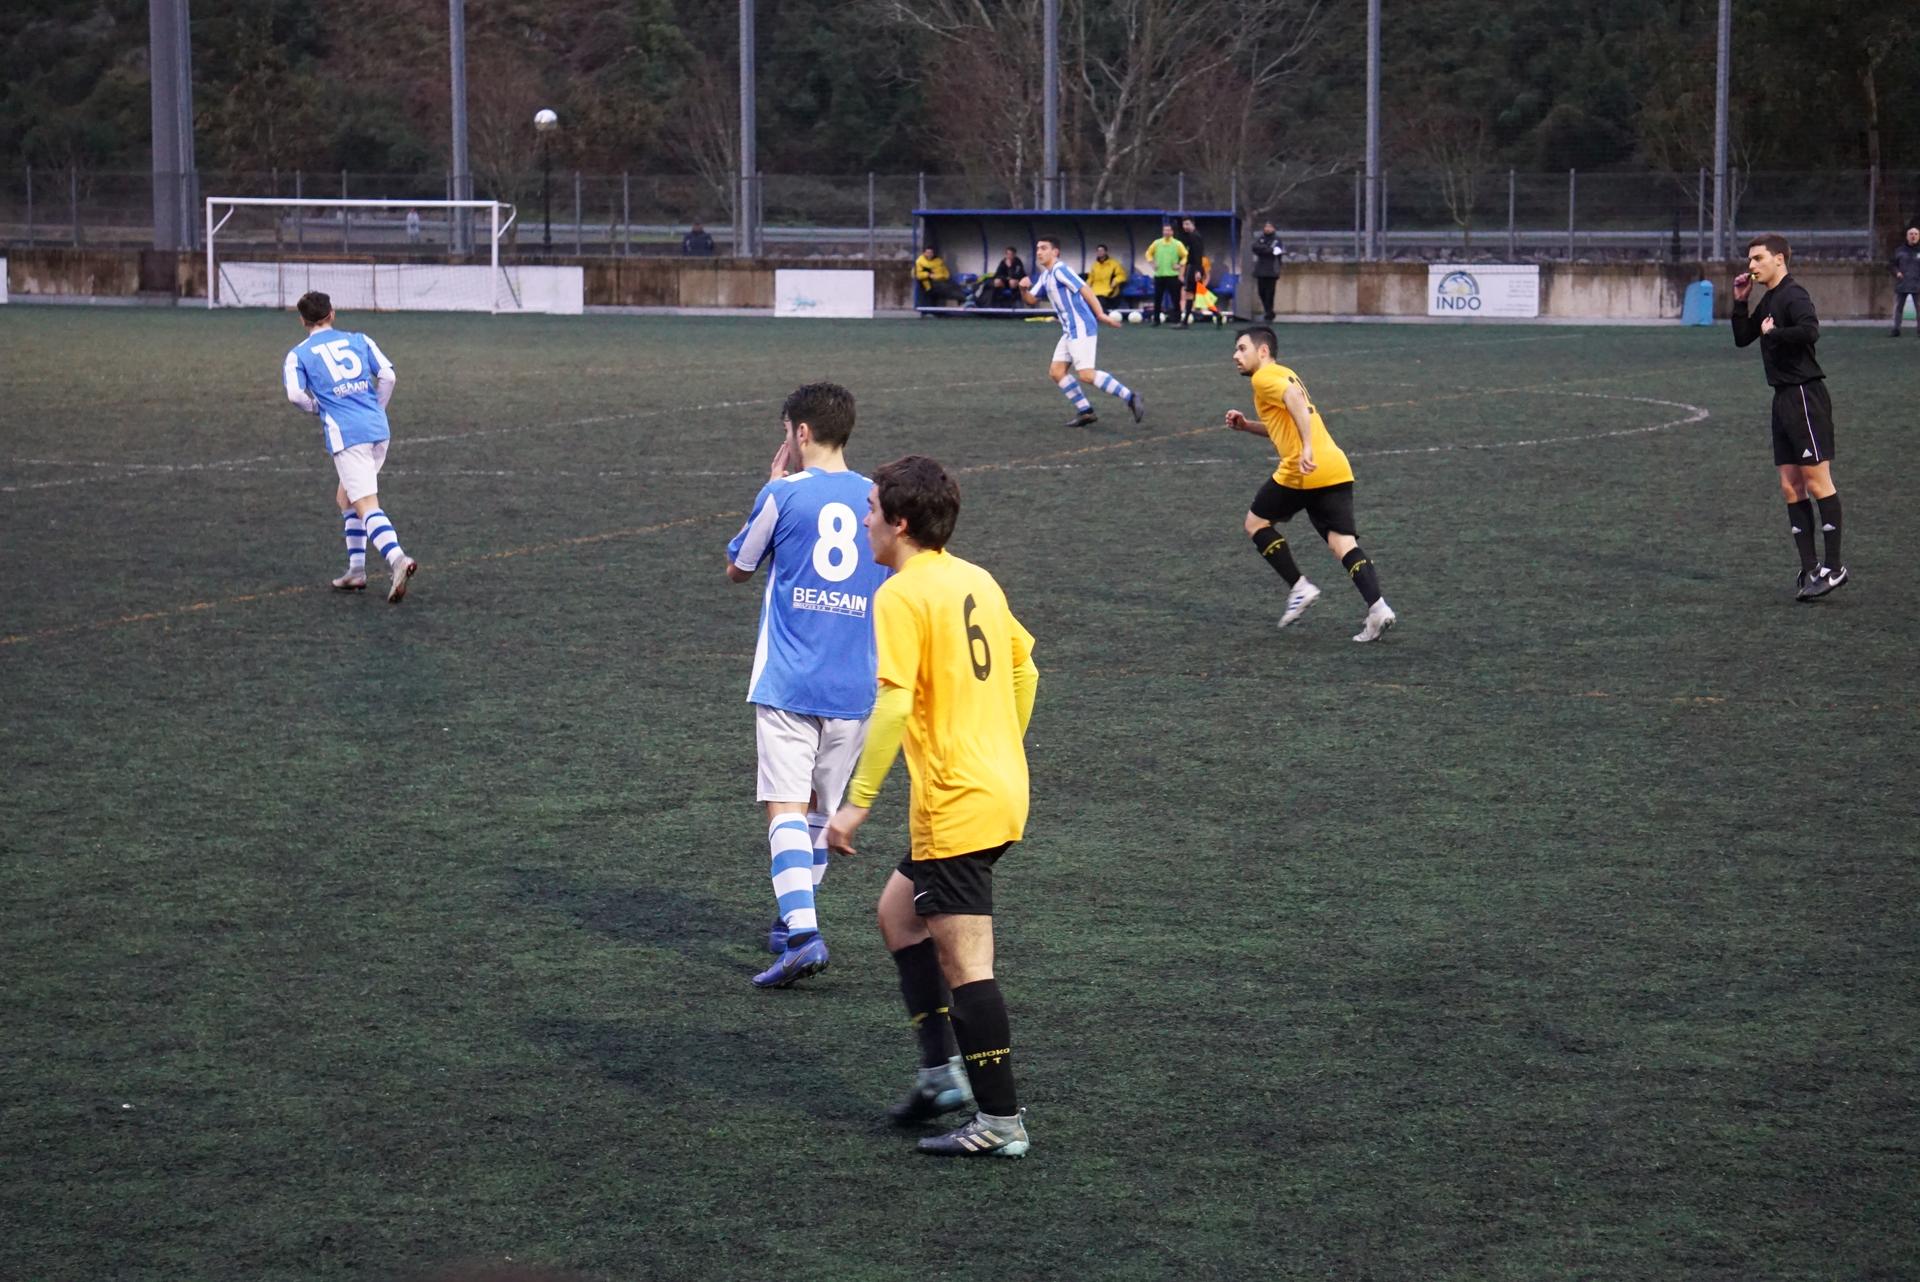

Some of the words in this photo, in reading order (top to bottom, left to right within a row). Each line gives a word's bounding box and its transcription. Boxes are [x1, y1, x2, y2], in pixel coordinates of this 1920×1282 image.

[1436, 296, 1481, 311] INDO
[310, 339, 363, 382] 15
[812, 502, 859, 582] 8
[793, 587, 867, 611] BEASAIN
[963, 593, 991, 682] 6
